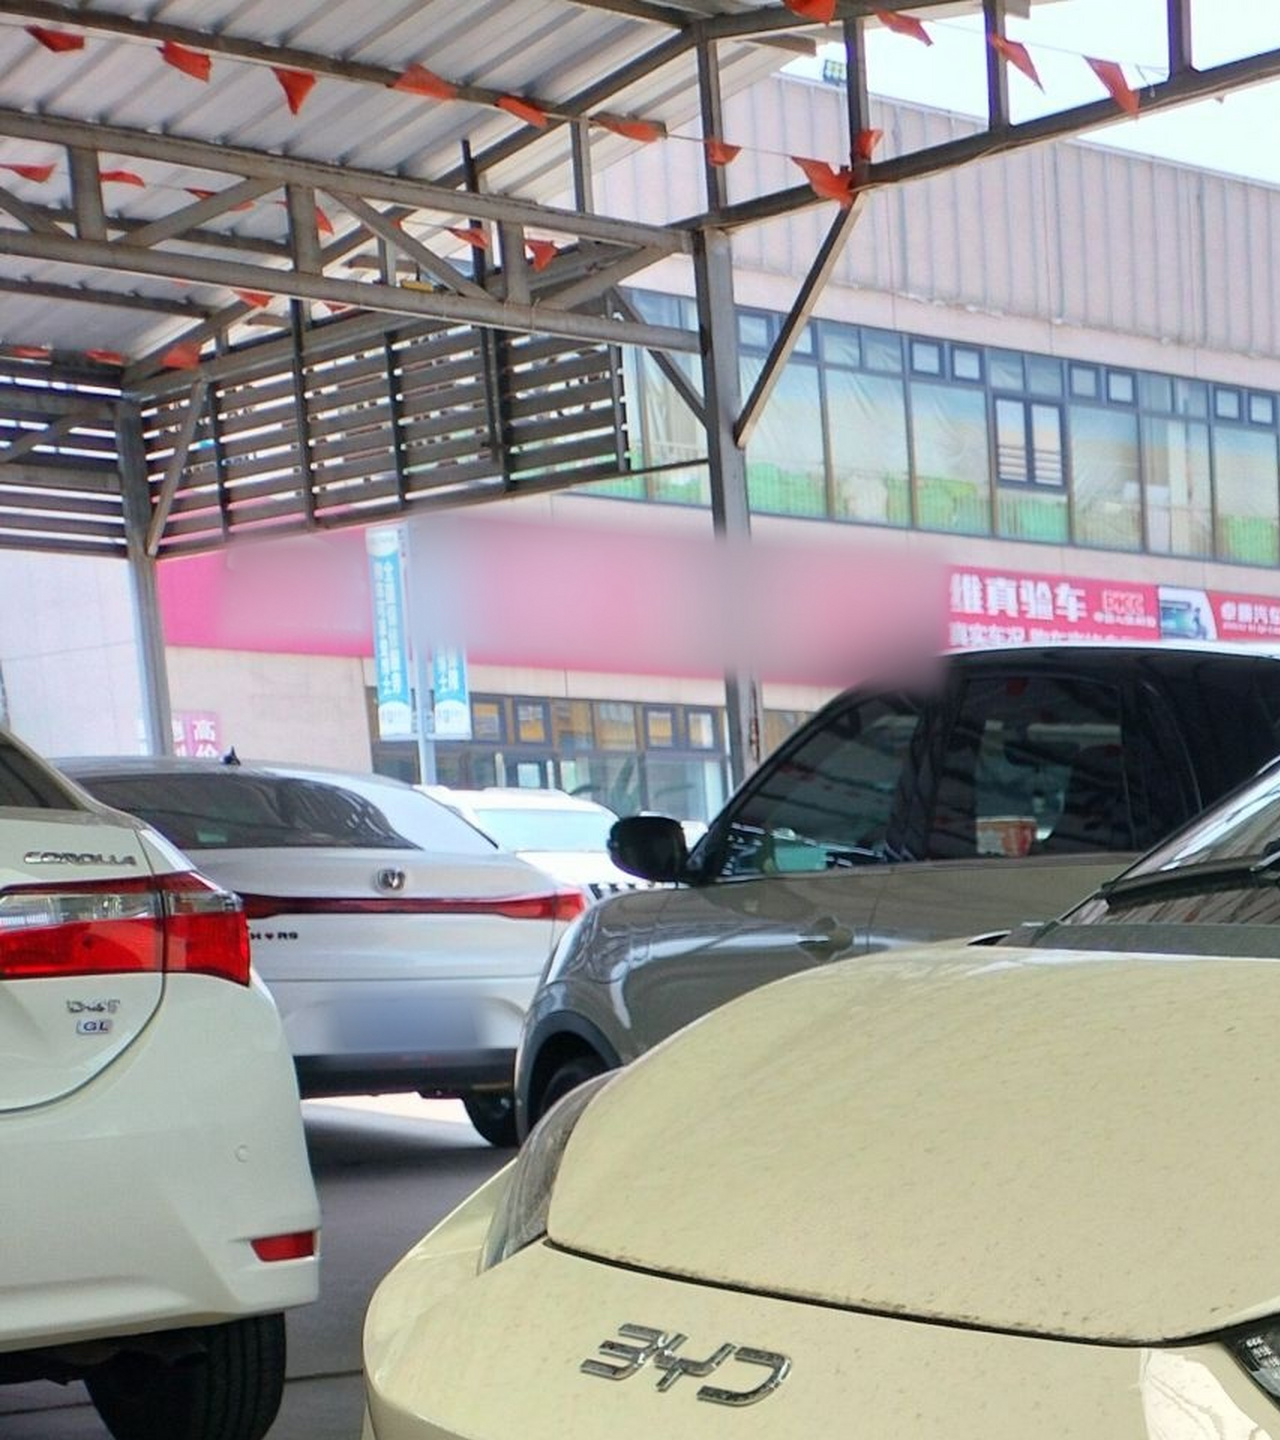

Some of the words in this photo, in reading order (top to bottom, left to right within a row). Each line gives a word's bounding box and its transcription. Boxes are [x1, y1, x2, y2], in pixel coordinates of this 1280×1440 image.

[950, 573, 1087, 623] 维真验车
[83, 1021, 108, 1031] GL
[580, 1323, 792, 1407] BYD
